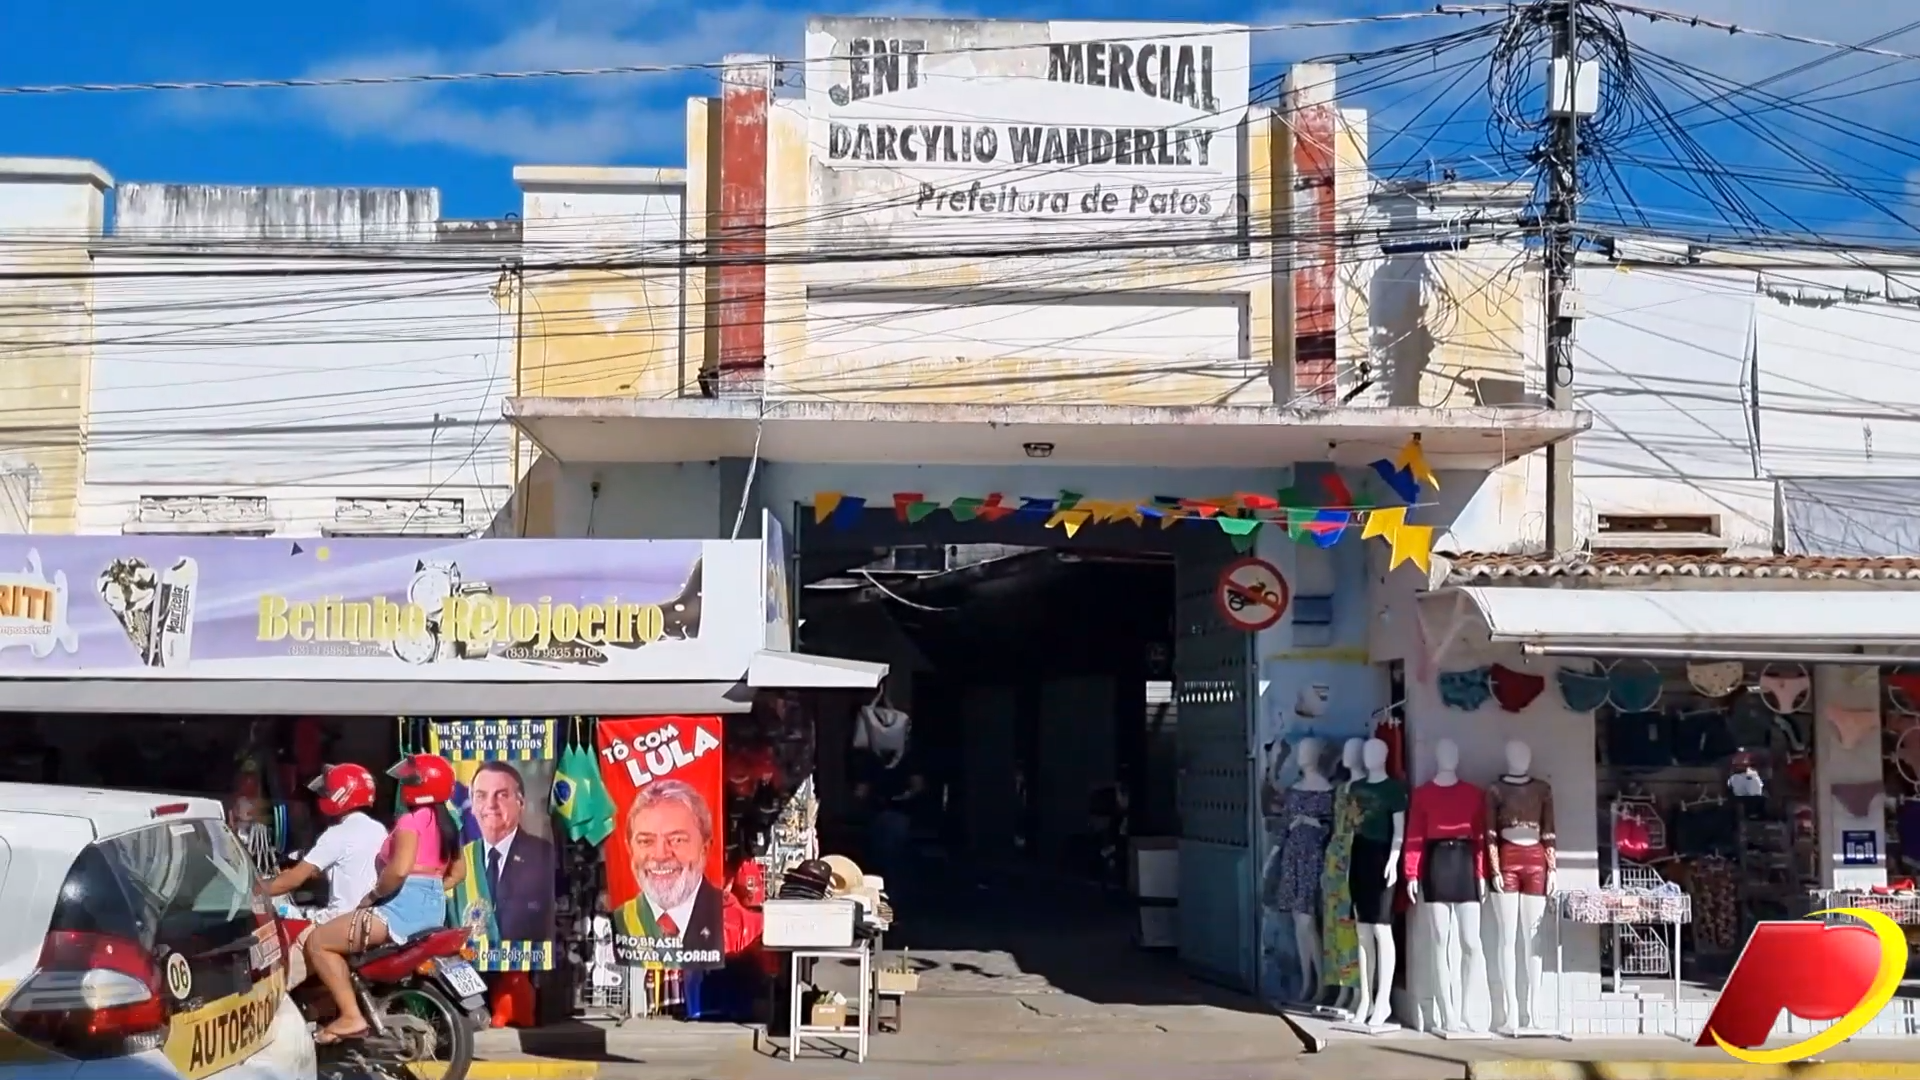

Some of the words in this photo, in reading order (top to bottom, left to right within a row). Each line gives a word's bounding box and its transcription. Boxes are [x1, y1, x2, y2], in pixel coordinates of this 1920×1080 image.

[1047, 43, 1220, 115] MERCIAL
[827, 122, 998, 164] DARCYLIO
[1007, 125, 1215, 167] WANDERLEY
[915, 180, 1070, 214] Prefeitura
[1080, 182, 1119, 214] de
[1128, 183, 1212, 215] Patos
[256, 594, 427, 642] Betinho
[440, 594, 665, 651] Relojoeiro
[542, 646, 572, 659] 9935
[437, 724, 471, 735] BRASIL
[473, 724, 504, 735] ACIMA
[505, 724, 518, 735] DE
[439, 740, 461, 750] DEUS
[463, 740, 493, 750] ACIMA
[495, 740, 509, 750] DE
[601, 738, 629, 764] TÔ
[633, 723, 679, 752] COM
[625, 725, 720, 788] LULA
[615, 934, 639, 947] PRO
[617, 948, 660, 962] VOLTAR
[662, 951, 673, 963] A
[675, 949, 721, 963] SORRIR
[170, 961, 189, 993] 06
